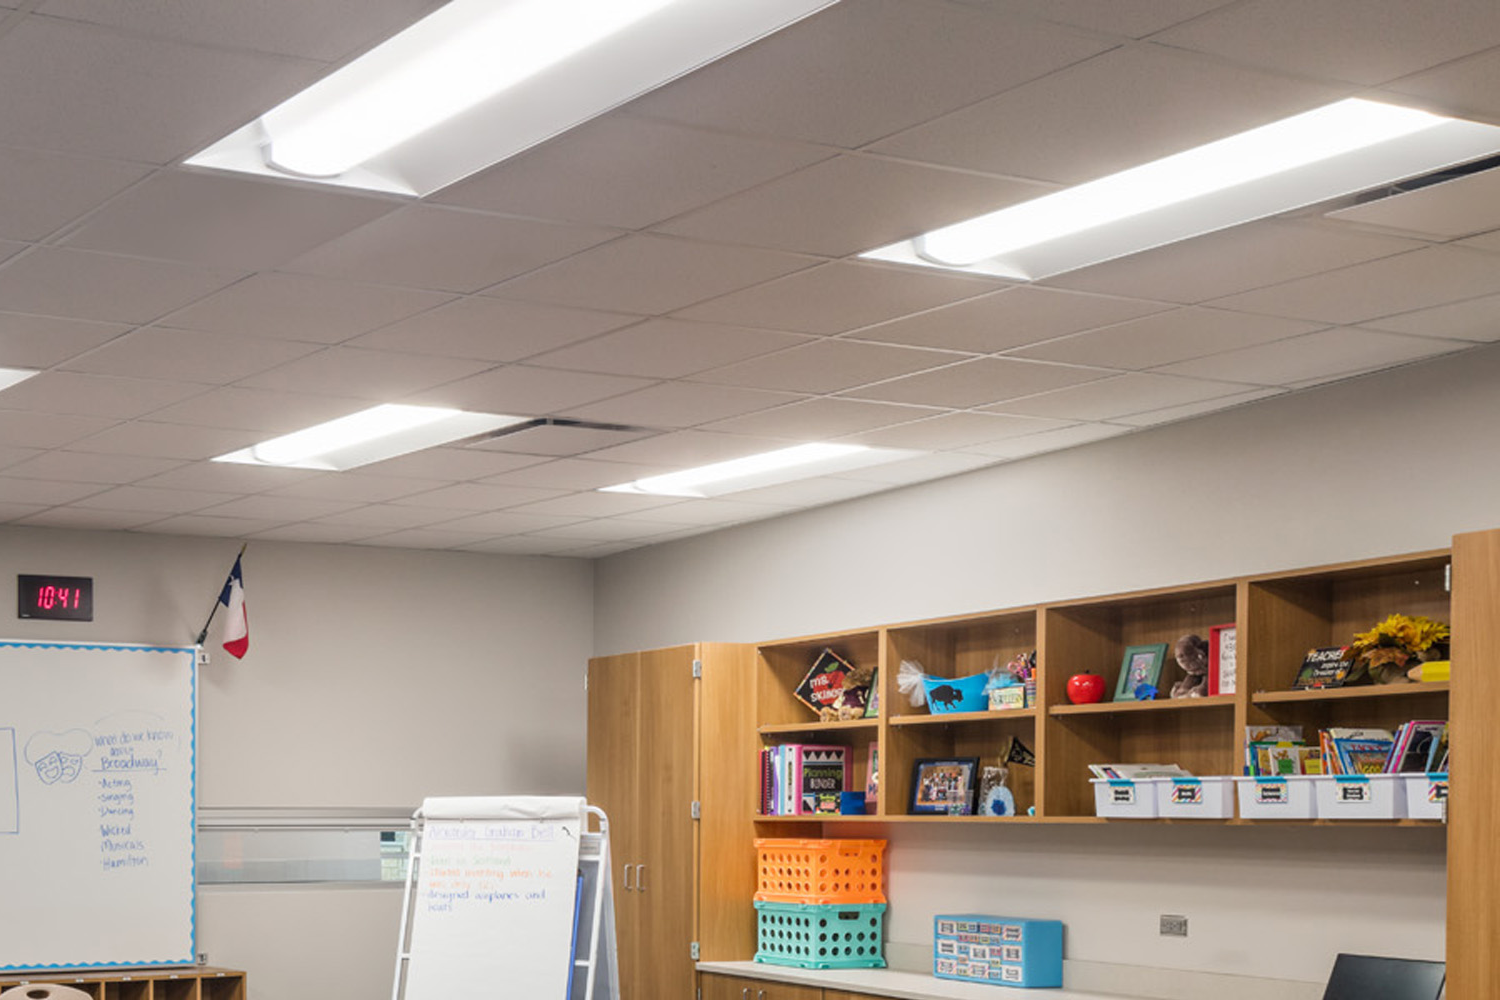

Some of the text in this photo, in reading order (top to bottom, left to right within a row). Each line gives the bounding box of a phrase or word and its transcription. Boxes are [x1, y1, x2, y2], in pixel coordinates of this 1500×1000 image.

[37, 585, 80, 610] 10:41
[803, 767, 843, 779] Planning
[102, 778, 132, 791] Acting
[103, 854, 149, 870] Hamilton
[525, 888, 546, 900] and
